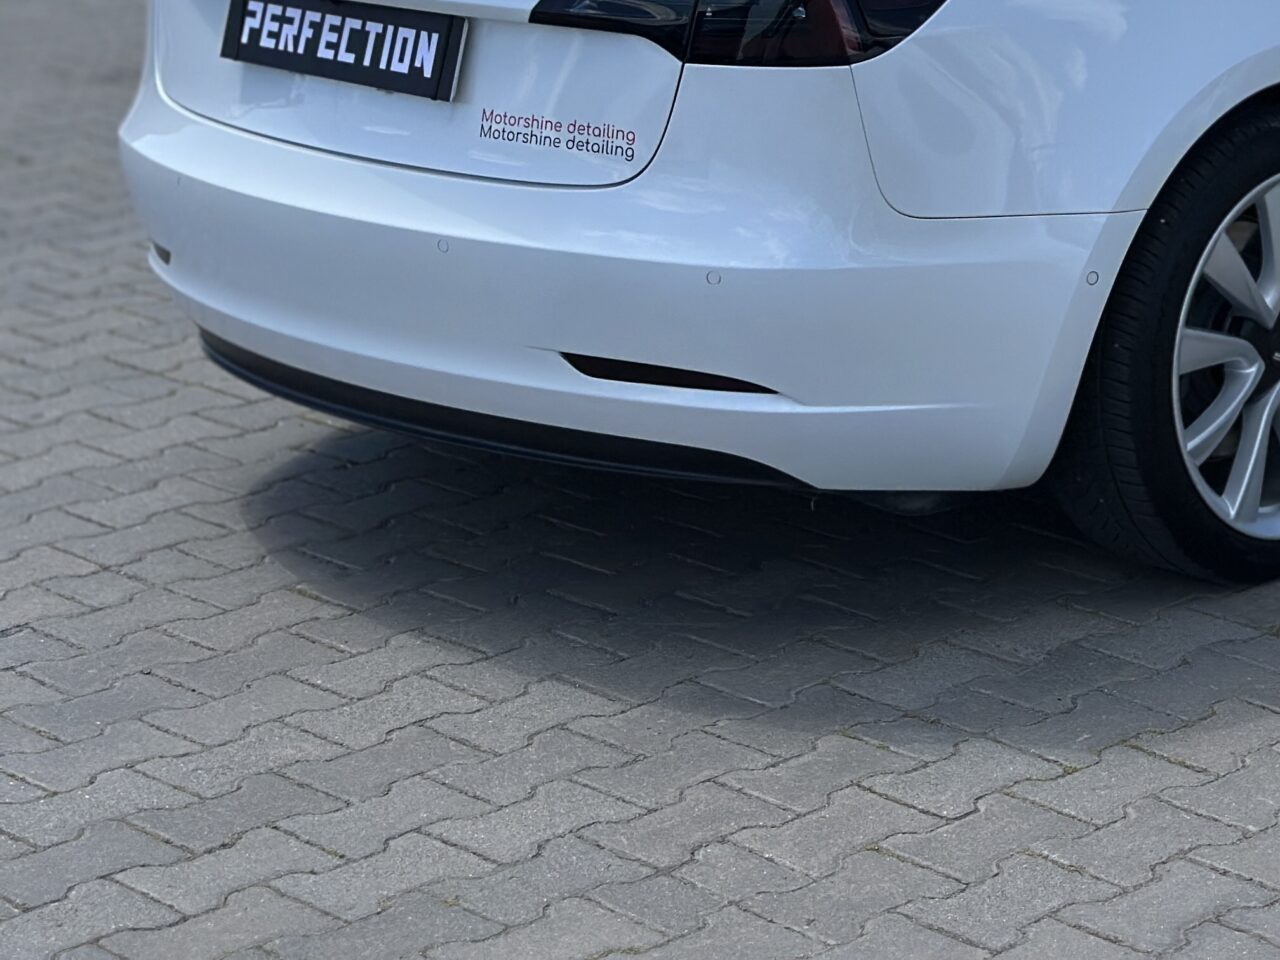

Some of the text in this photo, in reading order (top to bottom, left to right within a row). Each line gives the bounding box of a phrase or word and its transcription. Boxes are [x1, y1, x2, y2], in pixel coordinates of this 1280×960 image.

[241, 0, 440, 79] PERFECTION
[479, 124, 635, 162] Motorshine detailing
[481, 108, 636, 146] Motorshine detailing
